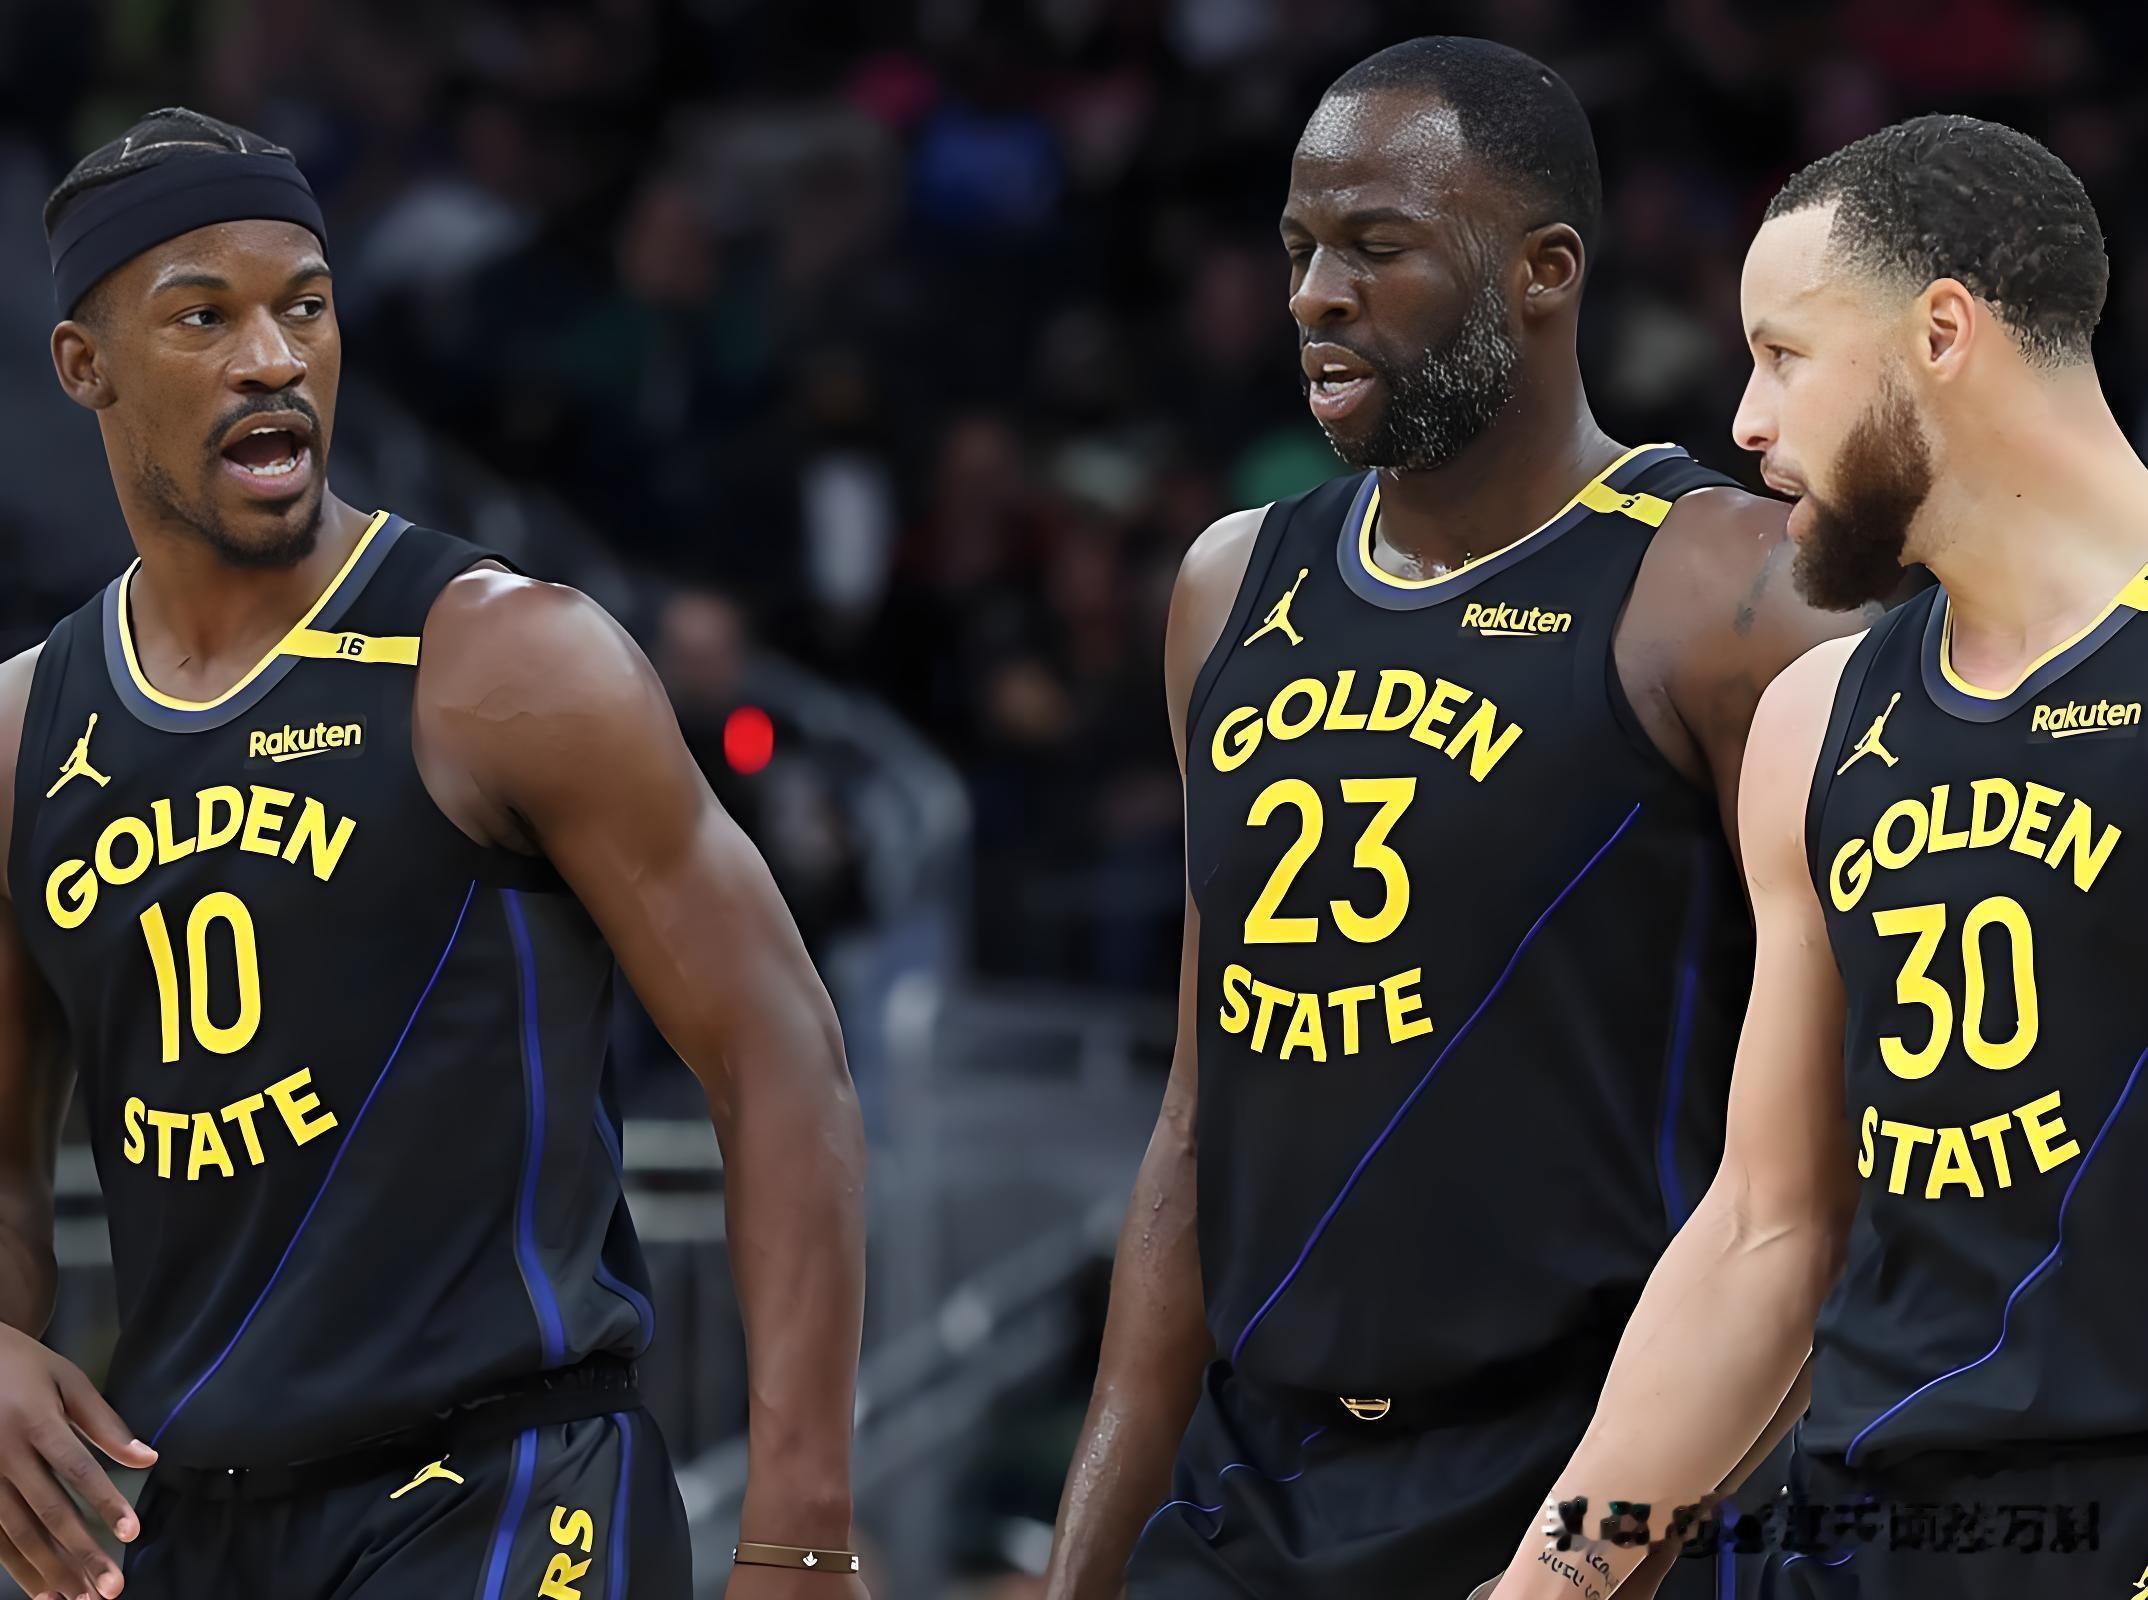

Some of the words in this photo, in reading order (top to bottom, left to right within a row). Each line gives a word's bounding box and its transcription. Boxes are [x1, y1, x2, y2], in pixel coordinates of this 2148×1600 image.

[336, 636, 365, 656] 16
[1461, 602, 1573, 636] Rakuten
[248, 720, 362, 762] Rakuten
[1210, 668, 1524, 783] GOLDEN
[2031, 698, 2142, 738] Rakuten
[45, 784, 357, 929] GOLDEN
[1243, 776, 1418, 945] 23
[1828, 776, 2122, 912] GOLDEN
[139, 891, 262, 1063] 10
[1218, 963, 1434, 1063] STATE
[1872, 895, 2040, 1080] 30
[122, 1067, 338, 1182] STATE
[1857, 1090, 2081, 1200] STATE
[537, 1505, 594, 1600] RS
